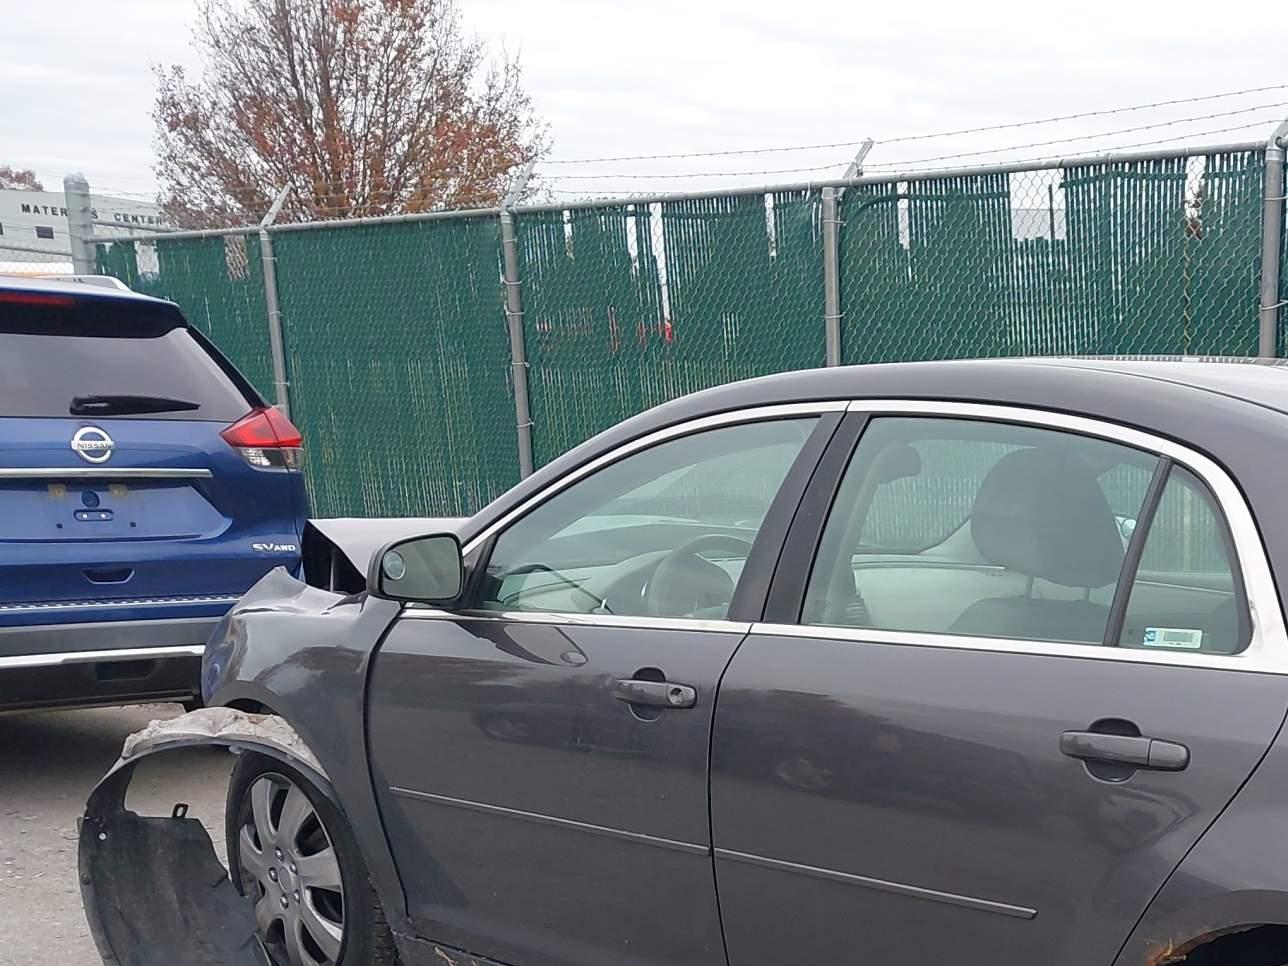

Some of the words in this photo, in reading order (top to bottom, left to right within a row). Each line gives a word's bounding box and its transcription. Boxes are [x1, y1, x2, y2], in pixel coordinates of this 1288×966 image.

[21, 203, 99, 220] MATERS
[114, 212, 163, 225] CENTER
[77, 441, 111, 449] NISSAN
